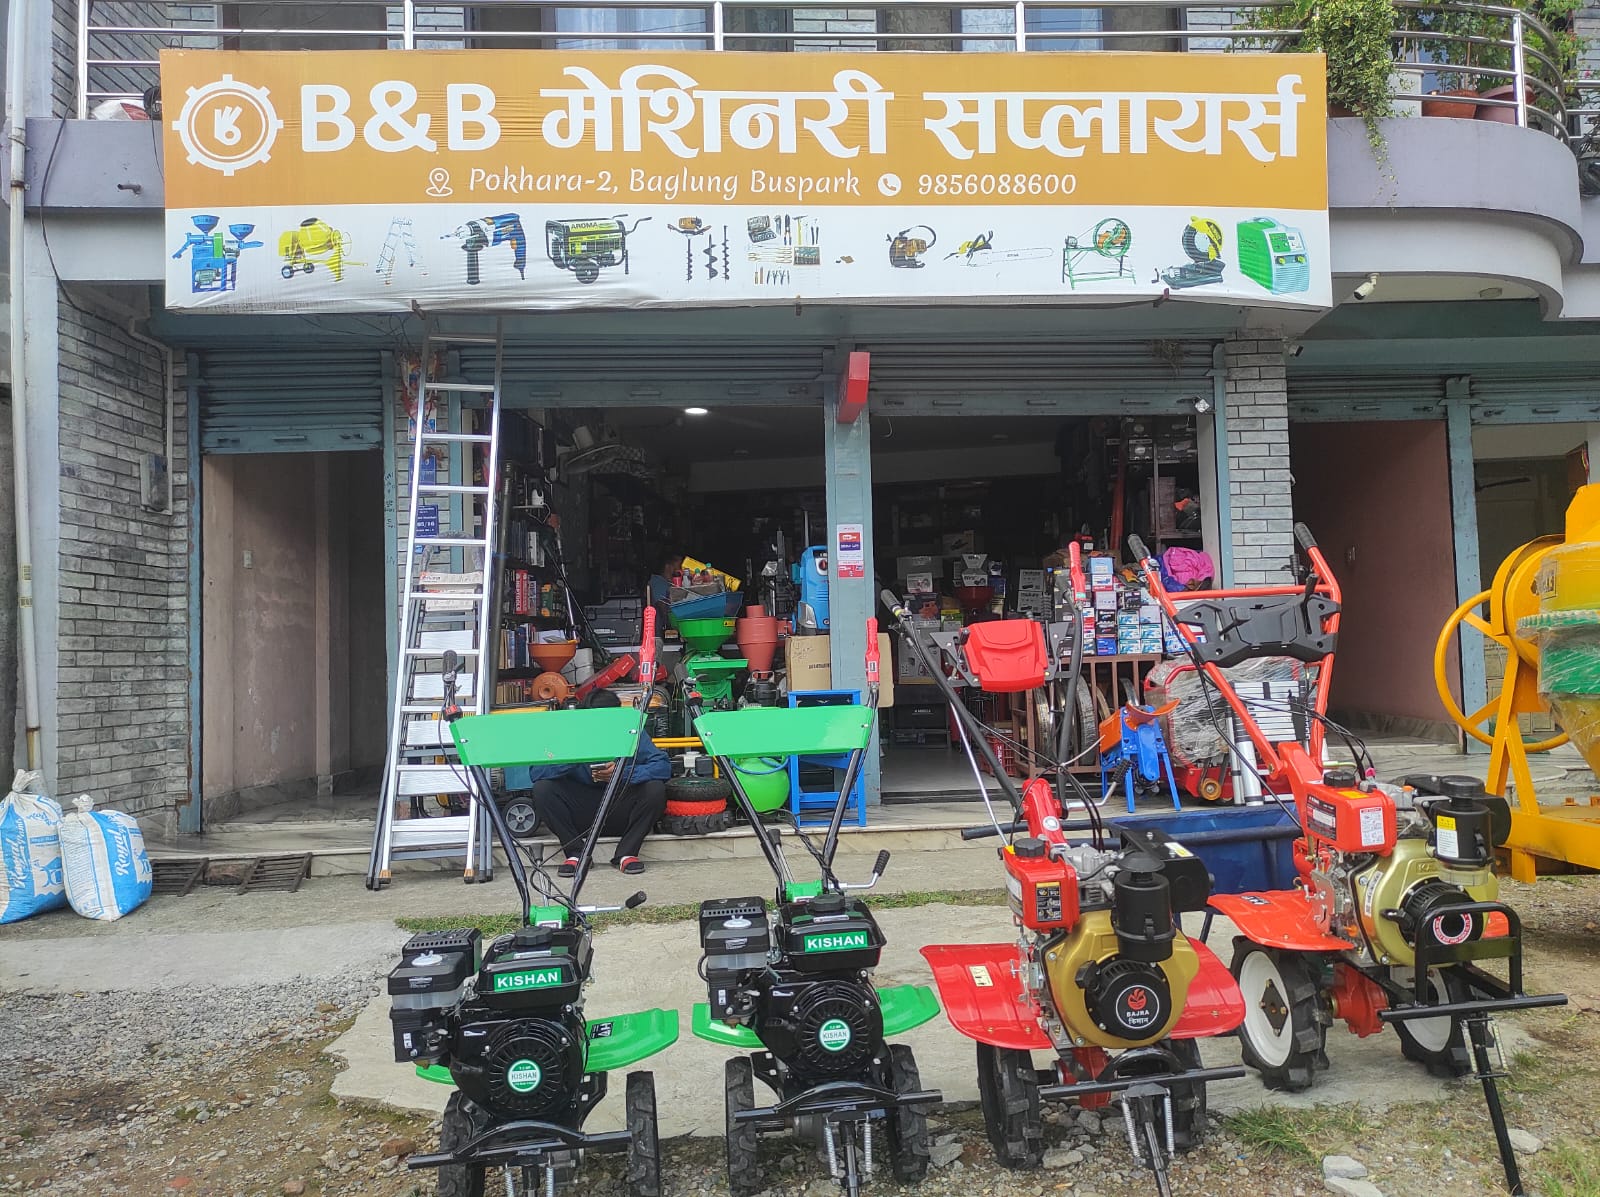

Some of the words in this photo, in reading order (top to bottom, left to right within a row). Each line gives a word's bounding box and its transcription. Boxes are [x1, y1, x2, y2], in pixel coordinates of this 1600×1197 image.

[300, 80, 502, 154] B&B
[922, 74, 1306, 162] सप्लायर्स
[469, 166, 618, 195] Pokhara-2,
[629, 167, 738, 201] Baglung
[750, 169, 861, 201] Buspark
[918, 174, 1077, 195] 9856088600
[106, 828, 131, 876] Royal
[808, 935, 865, 949] KISHAN
[497, 972, 558, 988] KISHAN
[823, 1031, 848, 1040] KISHAN
[511, 1071, 537, 1081] KISHAN
